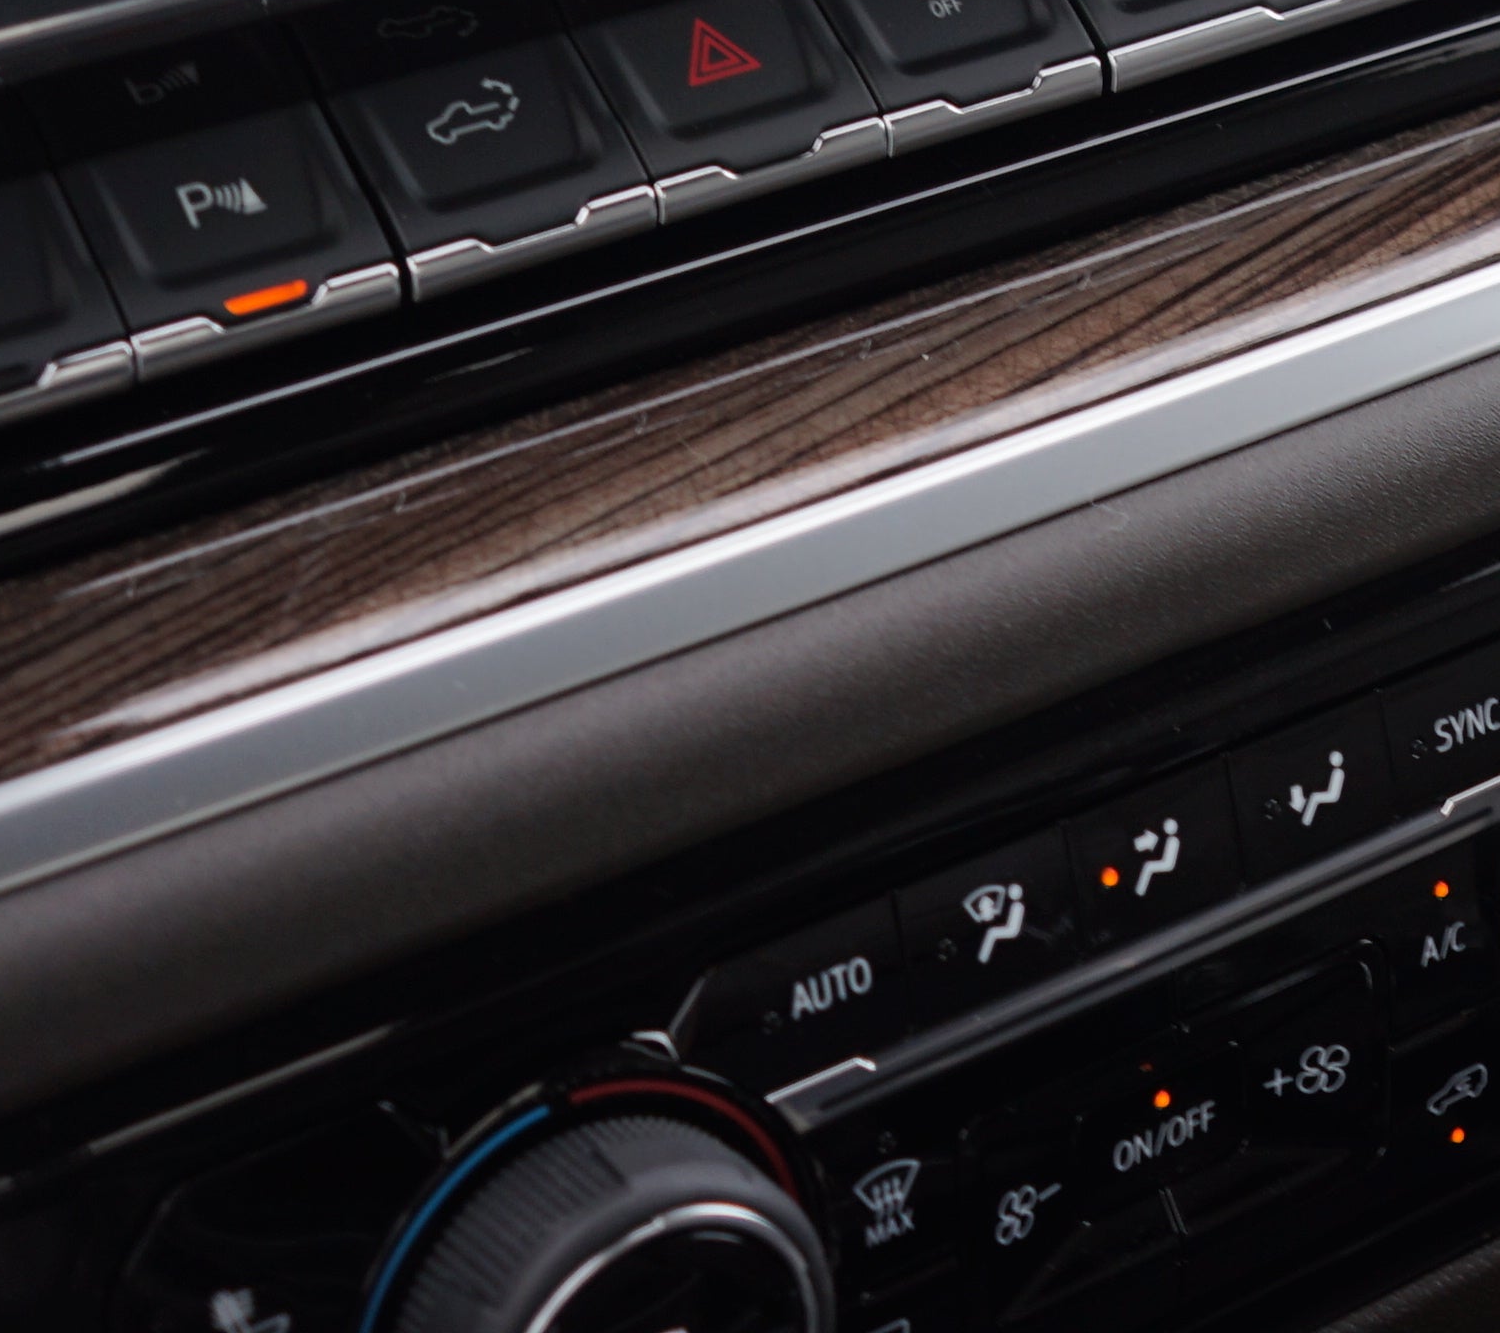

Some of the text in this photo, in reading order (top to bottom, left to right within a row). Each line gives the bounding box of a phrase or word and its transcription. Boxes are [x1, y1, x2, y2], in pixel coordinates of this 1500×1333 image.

[1419, 920, 1468, 968] A/C
[788, 955, 874, 1022] AUTO
[1112, 1100, 1217, 1174] ON/OFF
[865, 1209, 916, 1249] MAX
